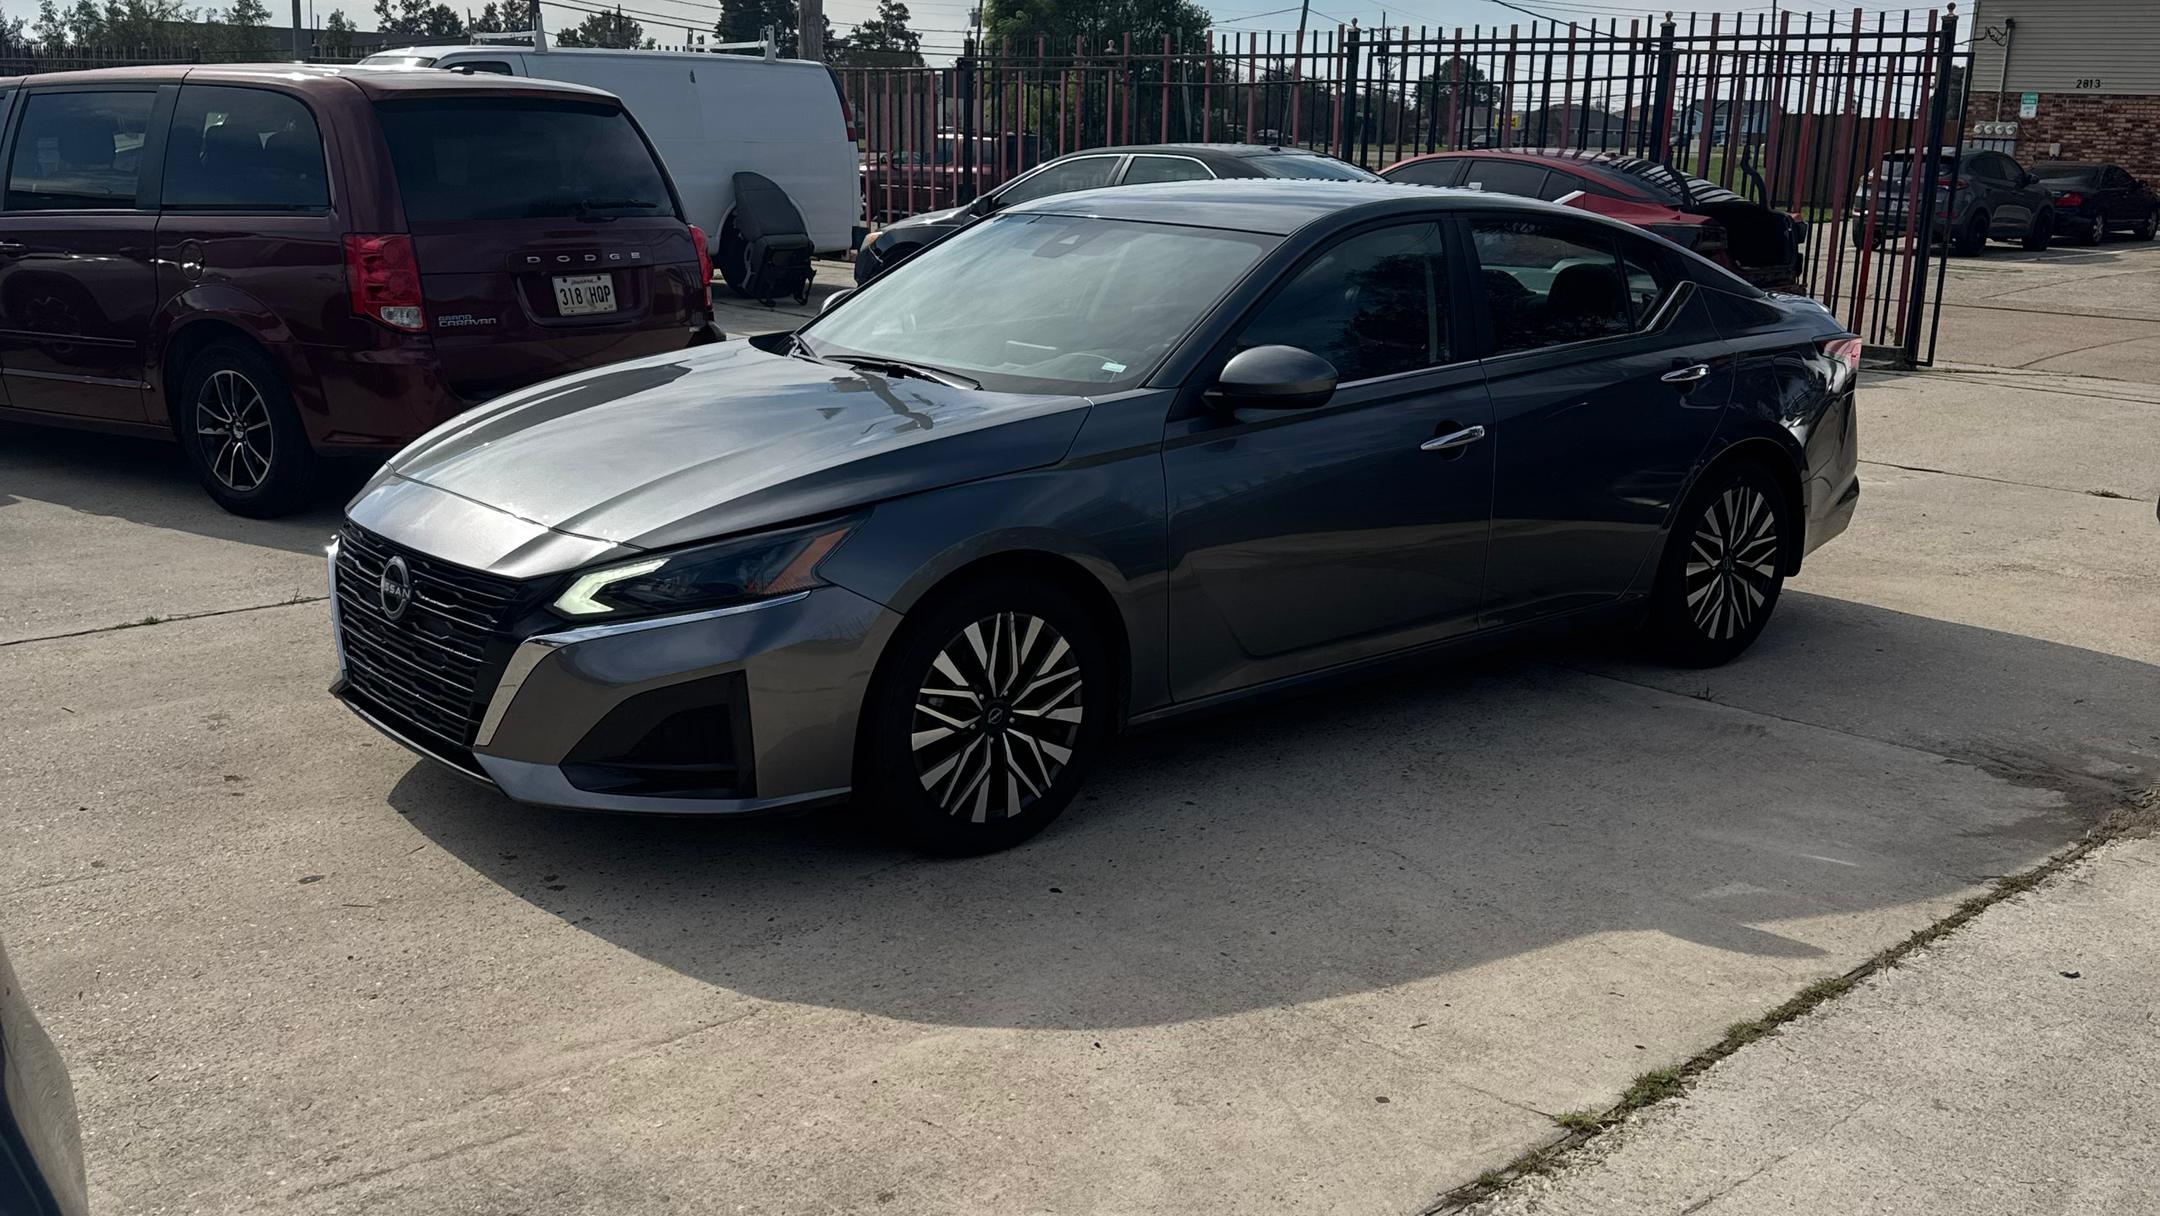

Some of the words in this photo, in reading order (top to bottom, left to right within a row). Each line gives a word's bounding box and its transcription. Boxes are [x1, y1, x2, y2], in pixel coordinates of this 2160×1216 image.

[2075, 79, 2101, 89] 2813
[527, 252, 640, 263] DODGE
[560, 288, 583, 306] 318
[439, 318, 496, 327] CARAVAN
